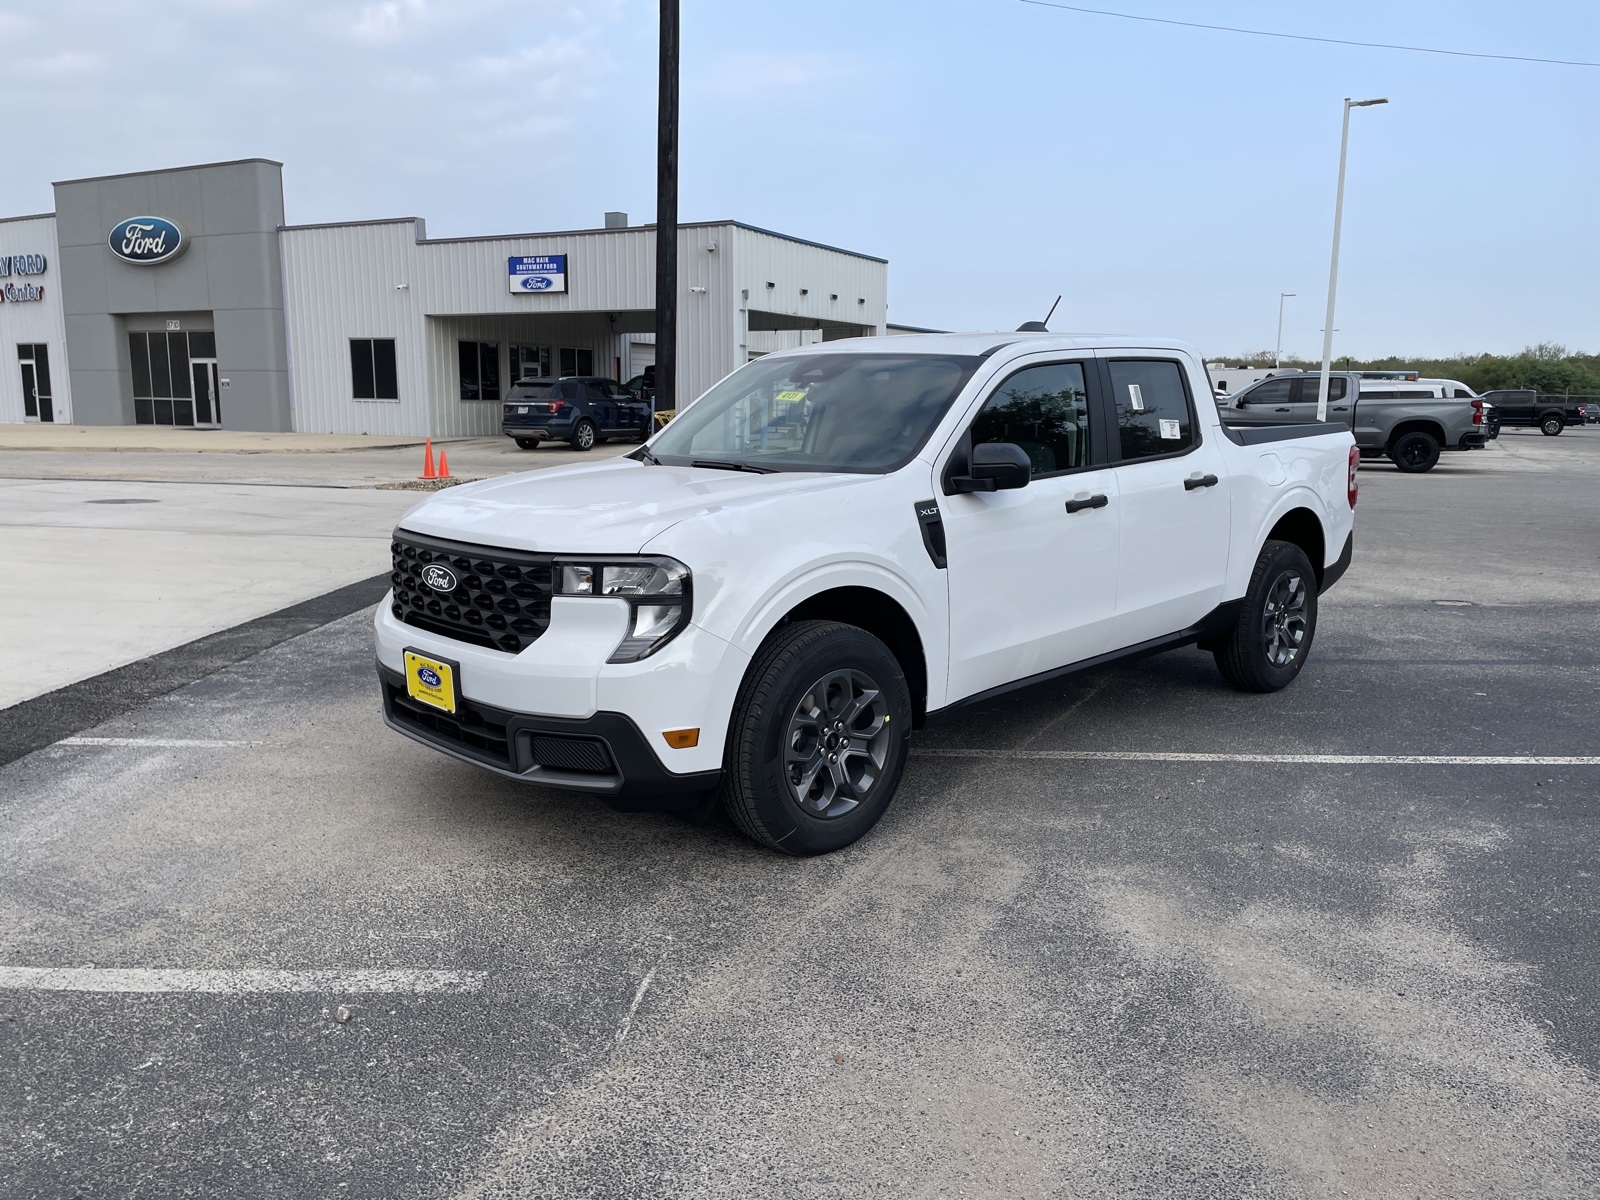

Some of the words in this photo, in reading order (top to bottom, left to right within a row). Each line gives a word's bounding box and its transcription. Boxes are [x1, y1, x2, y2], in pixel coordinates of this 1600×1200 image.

[122, 223, 166, 254] Ford
[12, 253, 46, 275] FORD
[4, 283, 43, 301] Center
[526, 277, 547, 289] Ford
[921, 507, 939, 516] XLT
[427, 567, 449, 588] Ford
[421, 669, 437, 685] Ford
